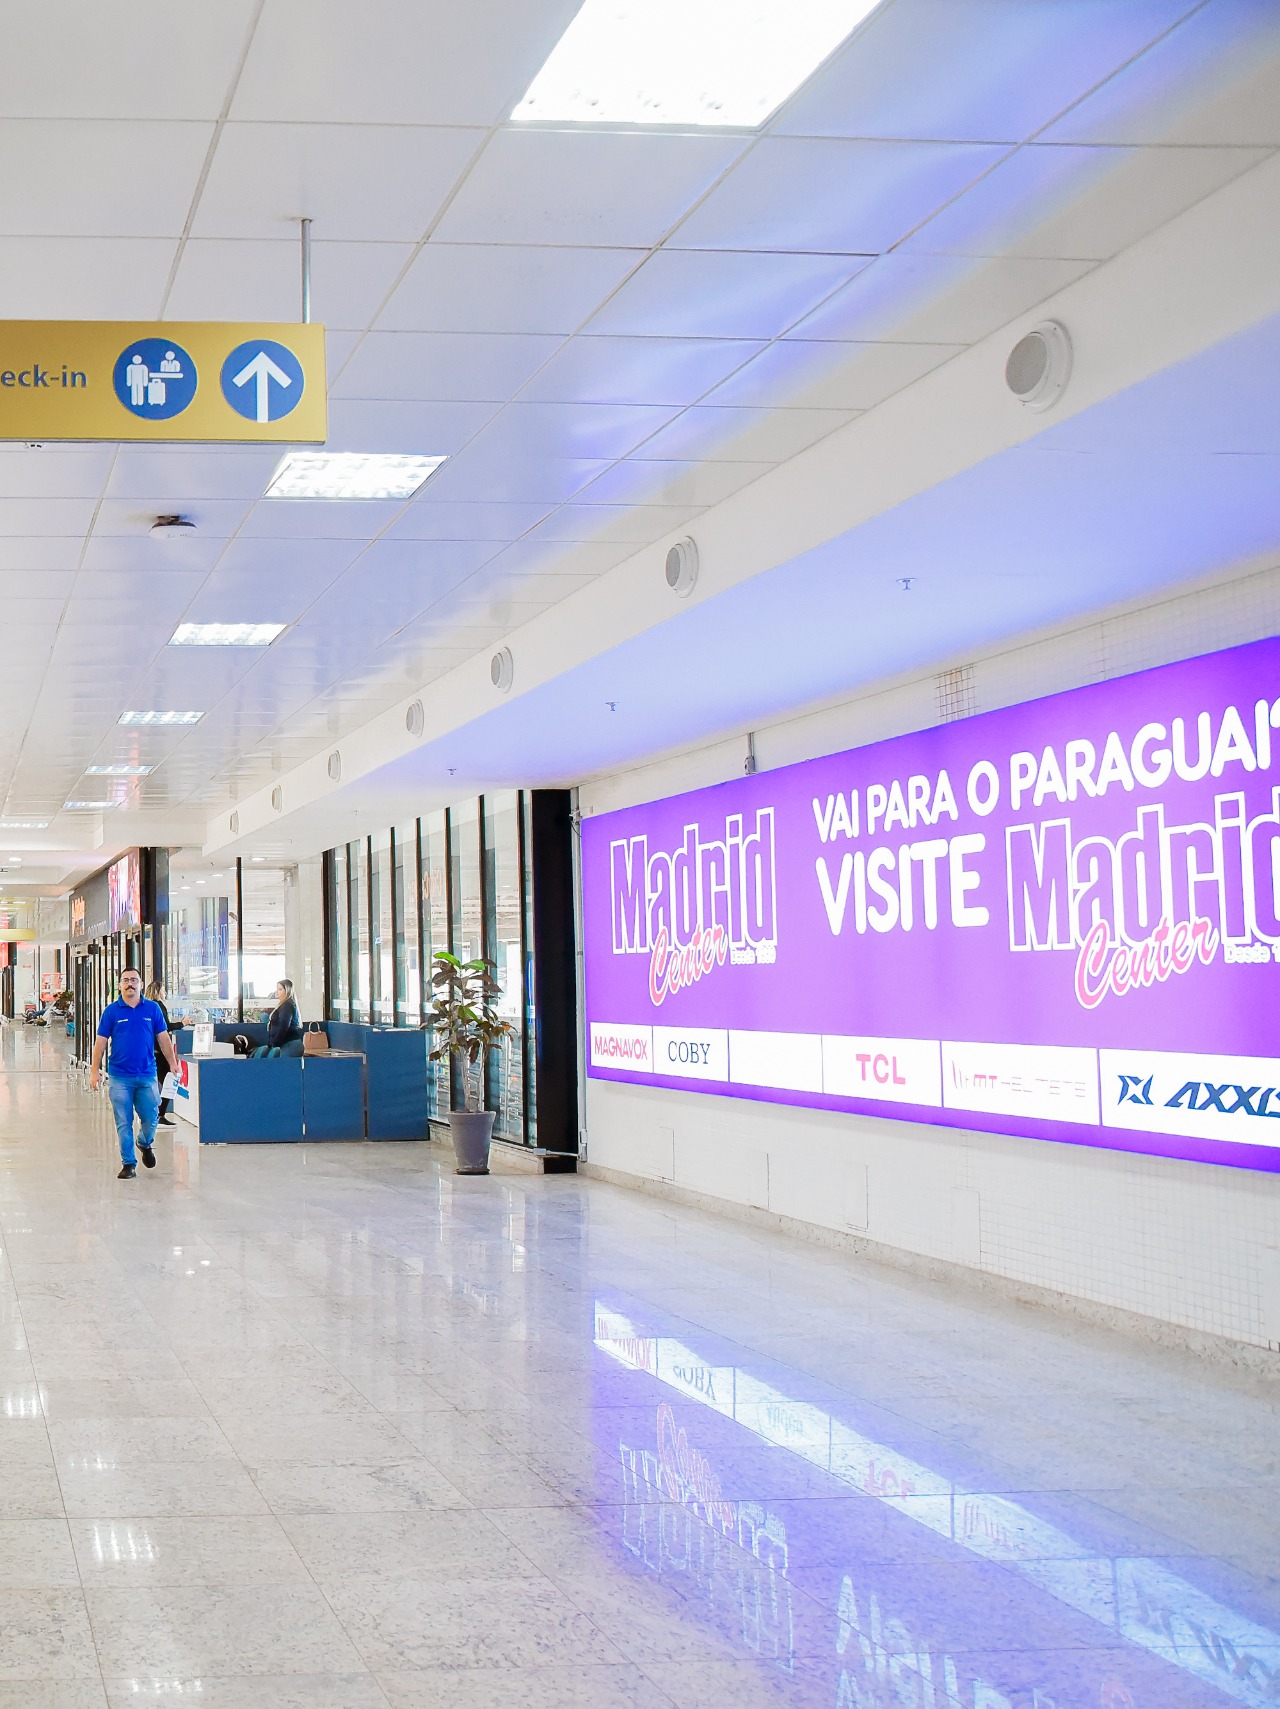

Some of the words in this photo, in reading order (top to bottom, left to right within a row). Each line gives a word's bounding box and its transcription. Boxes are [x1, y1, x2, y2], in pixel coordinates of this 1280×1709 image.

[813, 789, 859, 843] VAI
[866, 769, 958, 835] PARA
[967, 760, 999, 816] O
[610, 806, 777, 954] Madrid
[815, 833, 990, 936] VISITE
[649, 923, 728, 1006] Center
[1075, 916, 1219, 1009] Center
[594, 1035, 648, 1061] MAGNAVOX
[668, 1040, 711, 1065] COBY
[855, 1053, 906, 1085] TCL
